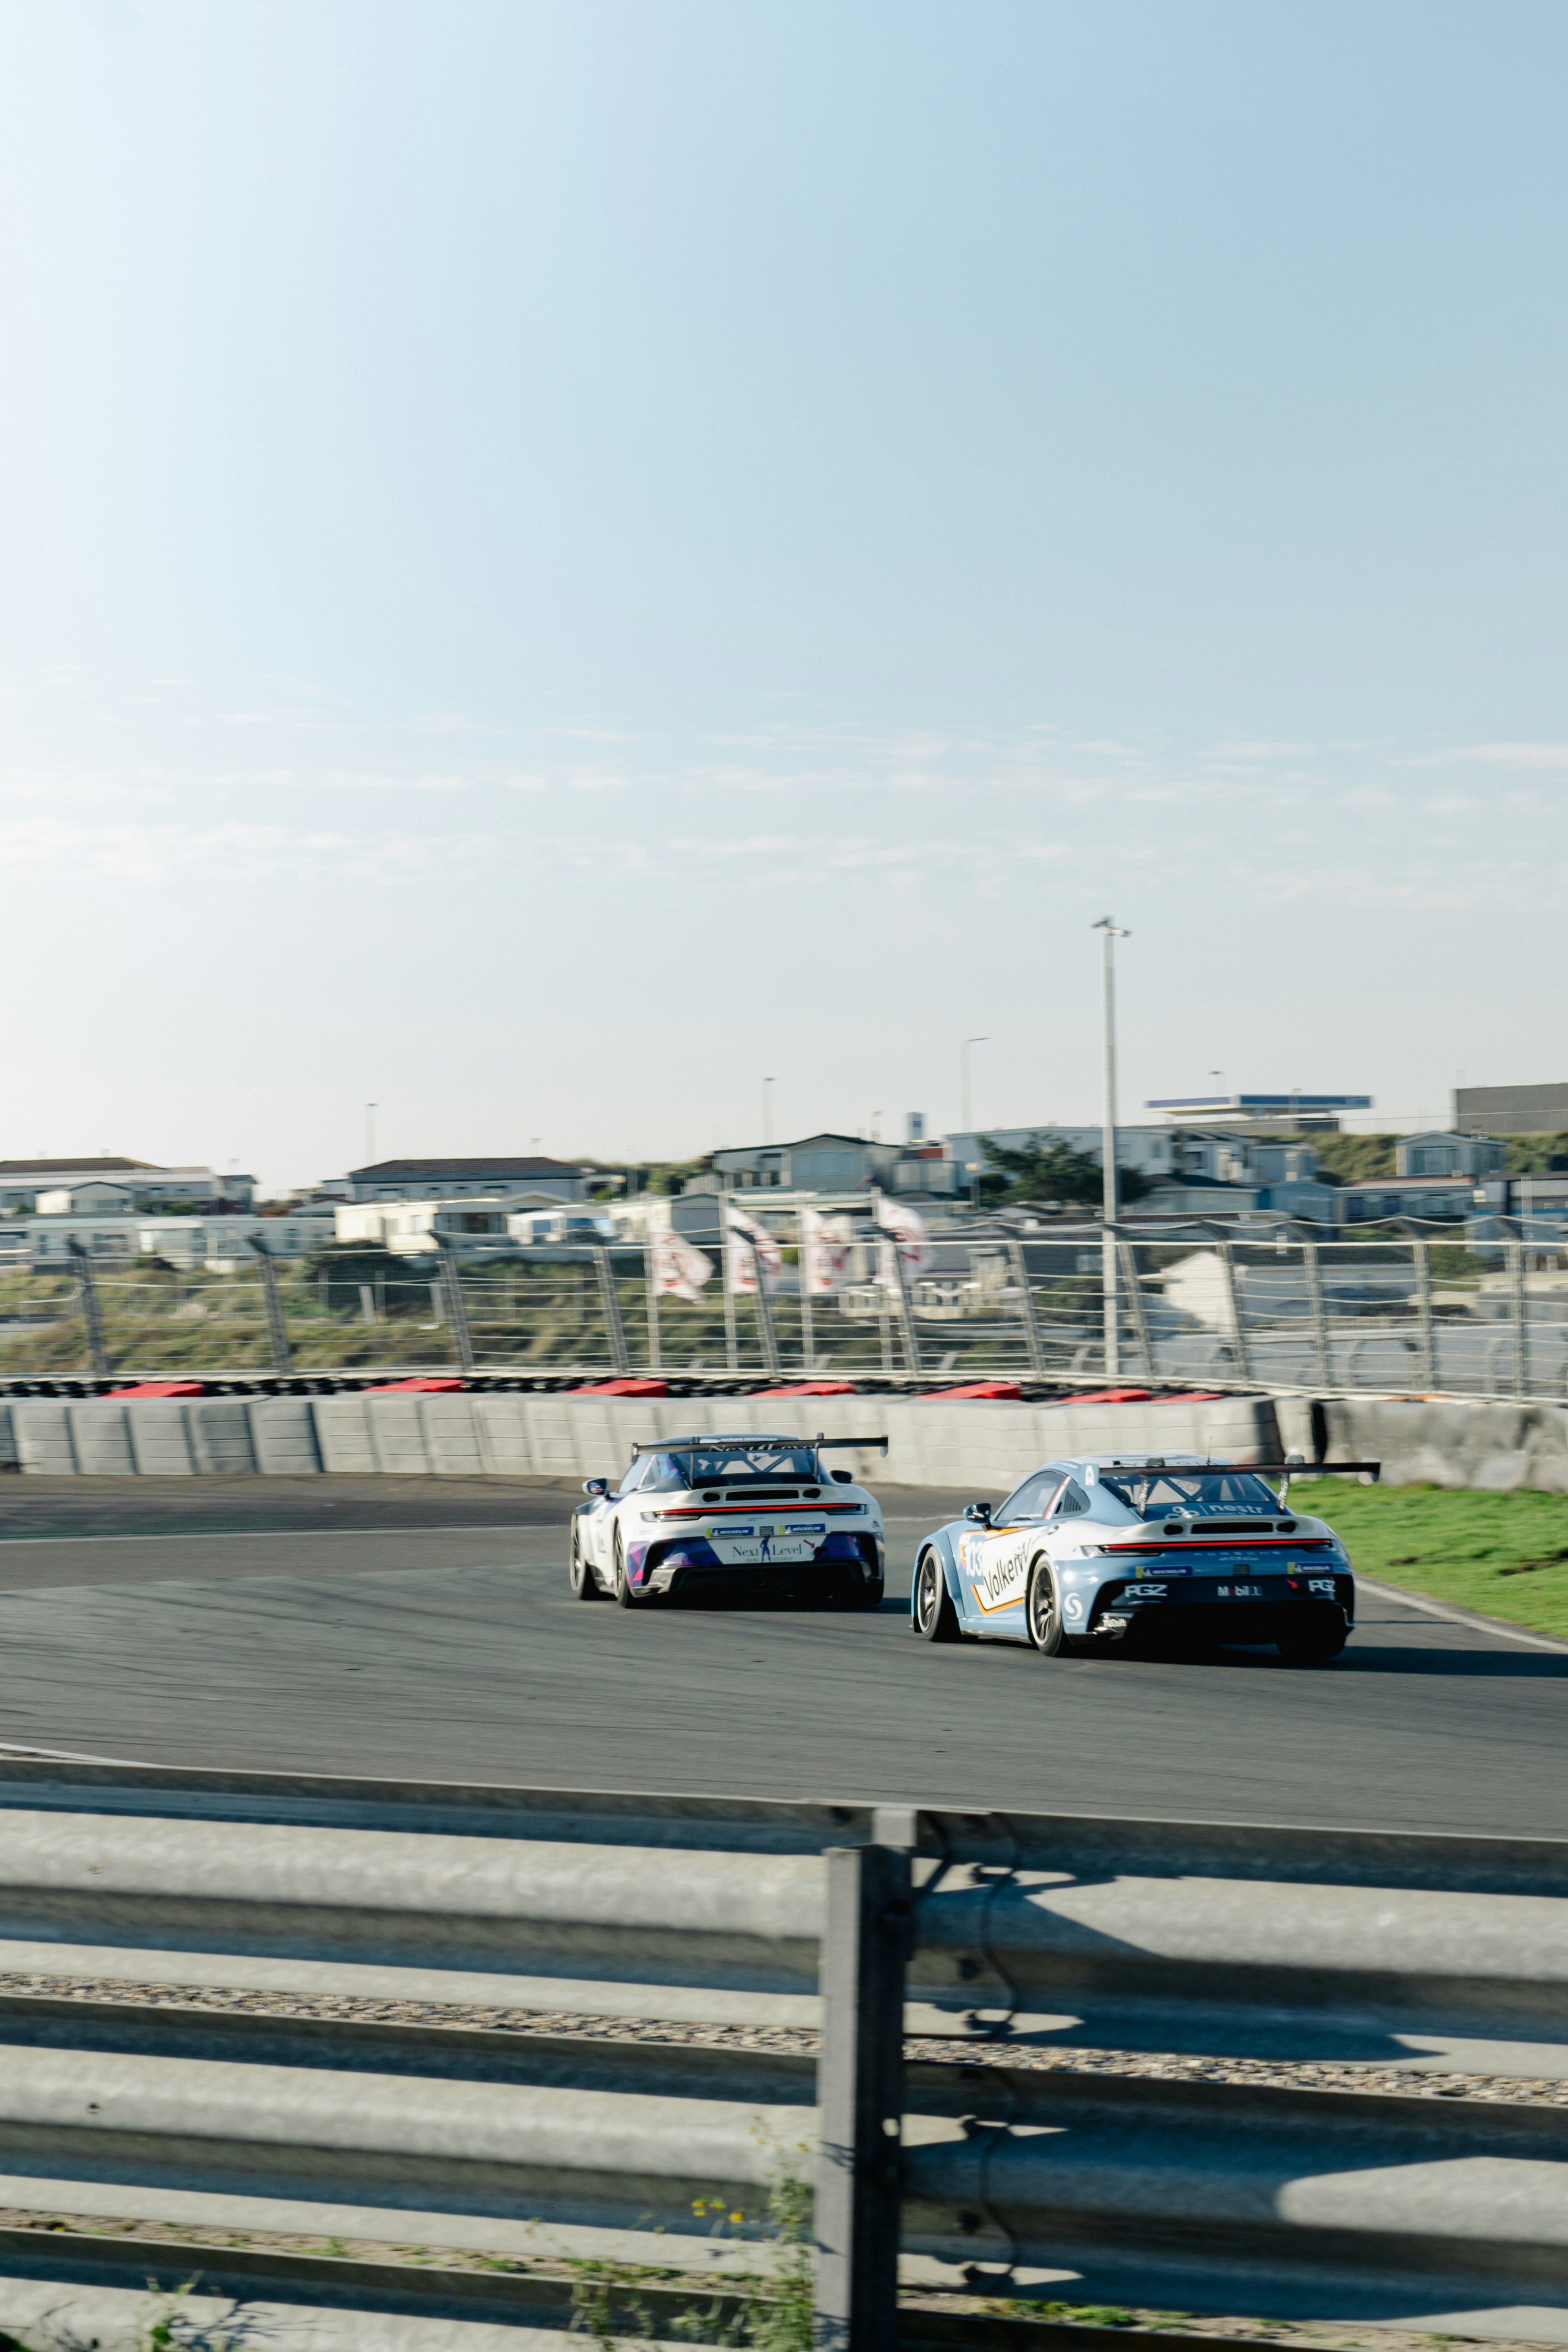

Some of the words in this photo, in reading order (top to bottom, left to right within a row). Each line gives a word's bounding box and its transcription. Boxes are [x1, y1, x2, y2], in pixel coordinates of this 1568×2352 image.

[1208, 1505, 1263, 1514] nestr
[732, 1546, 759, 1558] Next
[772, 1543, 802, 1555] Level
[1124, 1584, 1168, 1597] PGZ
[1218, 1585, 1250, 1597] Mobil
